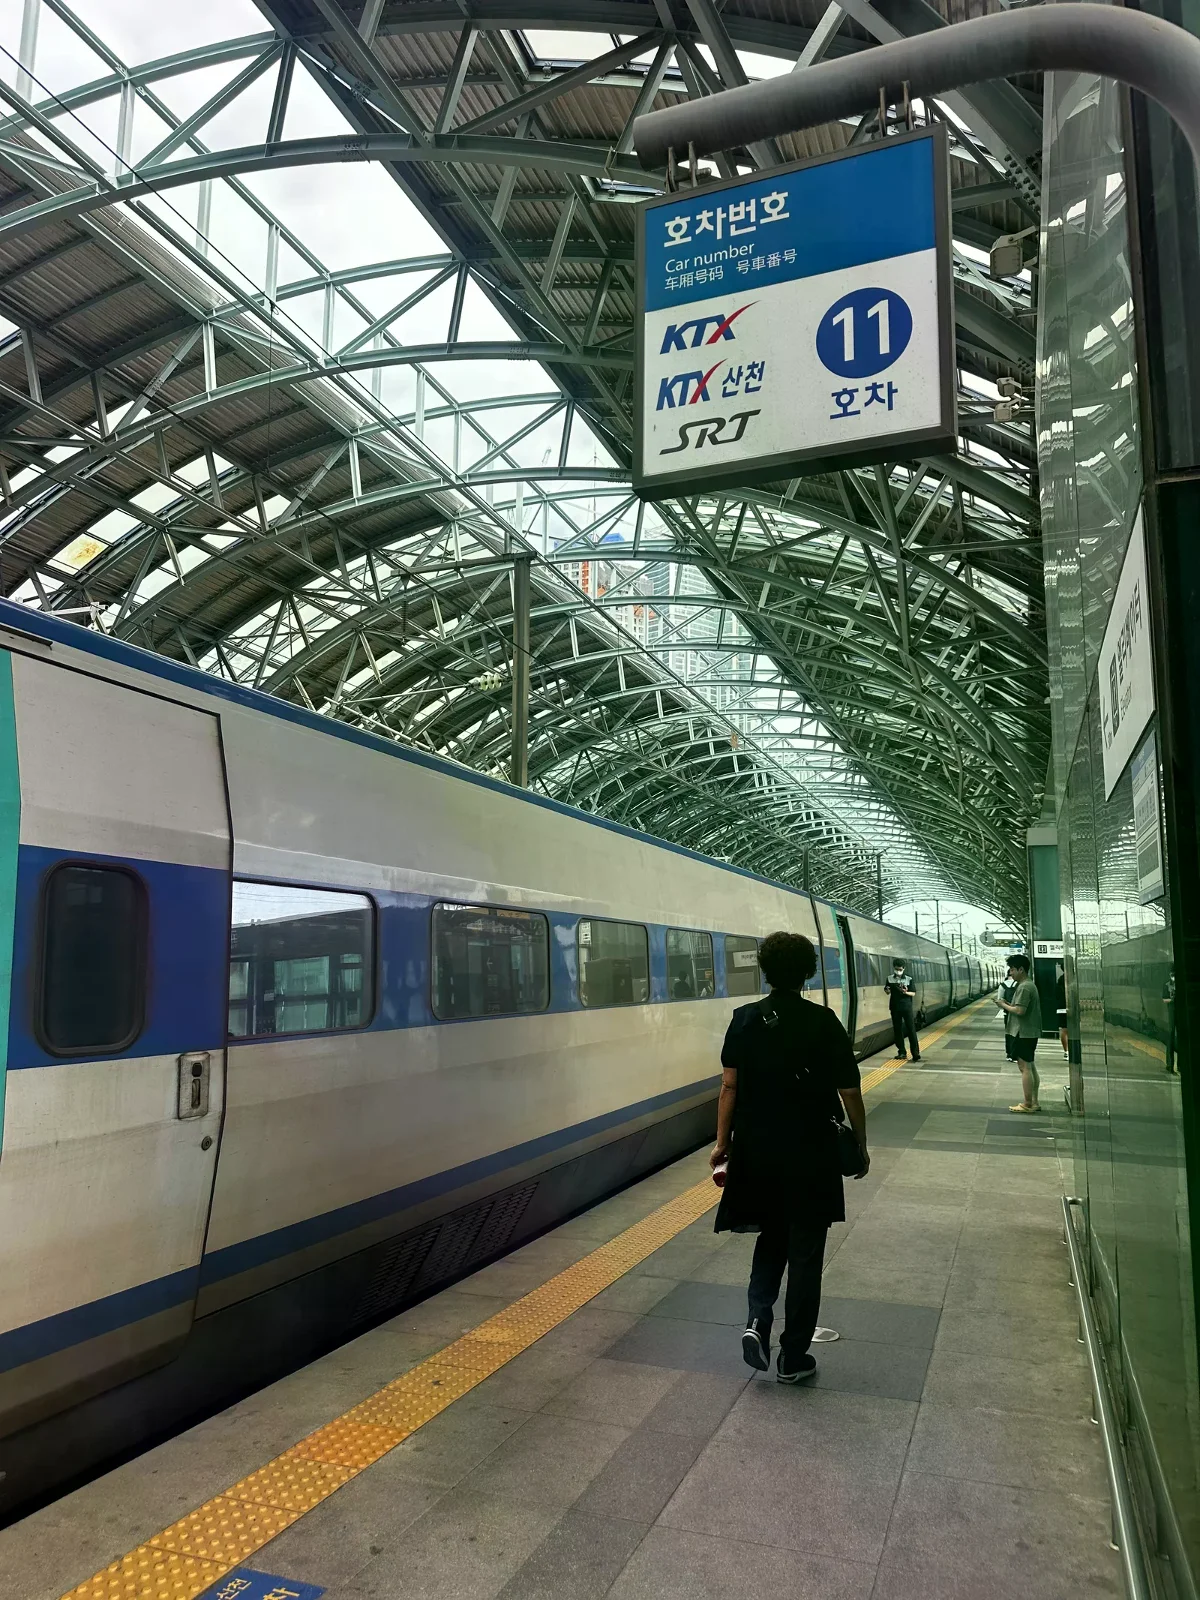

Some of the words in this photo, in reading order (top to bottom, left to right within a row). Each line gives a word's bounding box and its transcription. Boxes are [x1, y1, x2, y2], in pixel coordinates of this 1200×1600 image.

[664, 191, 790, 248] 호차번호
[664, 265, 724, 291] 车厢号码
[736, 248, 798, 275] 号車番号
[665, 258, 690, 273] Car
[694, 243, 755, 267] number
[659, 301, 759, 355] KTX
[832, 299, 891, 362] 11
[655, 359, 727, 411] KTX
[722, 360, 766, 399] 산천
[829, 381, 898, 420] 호차
[659, 409, 762, 456] SRT
